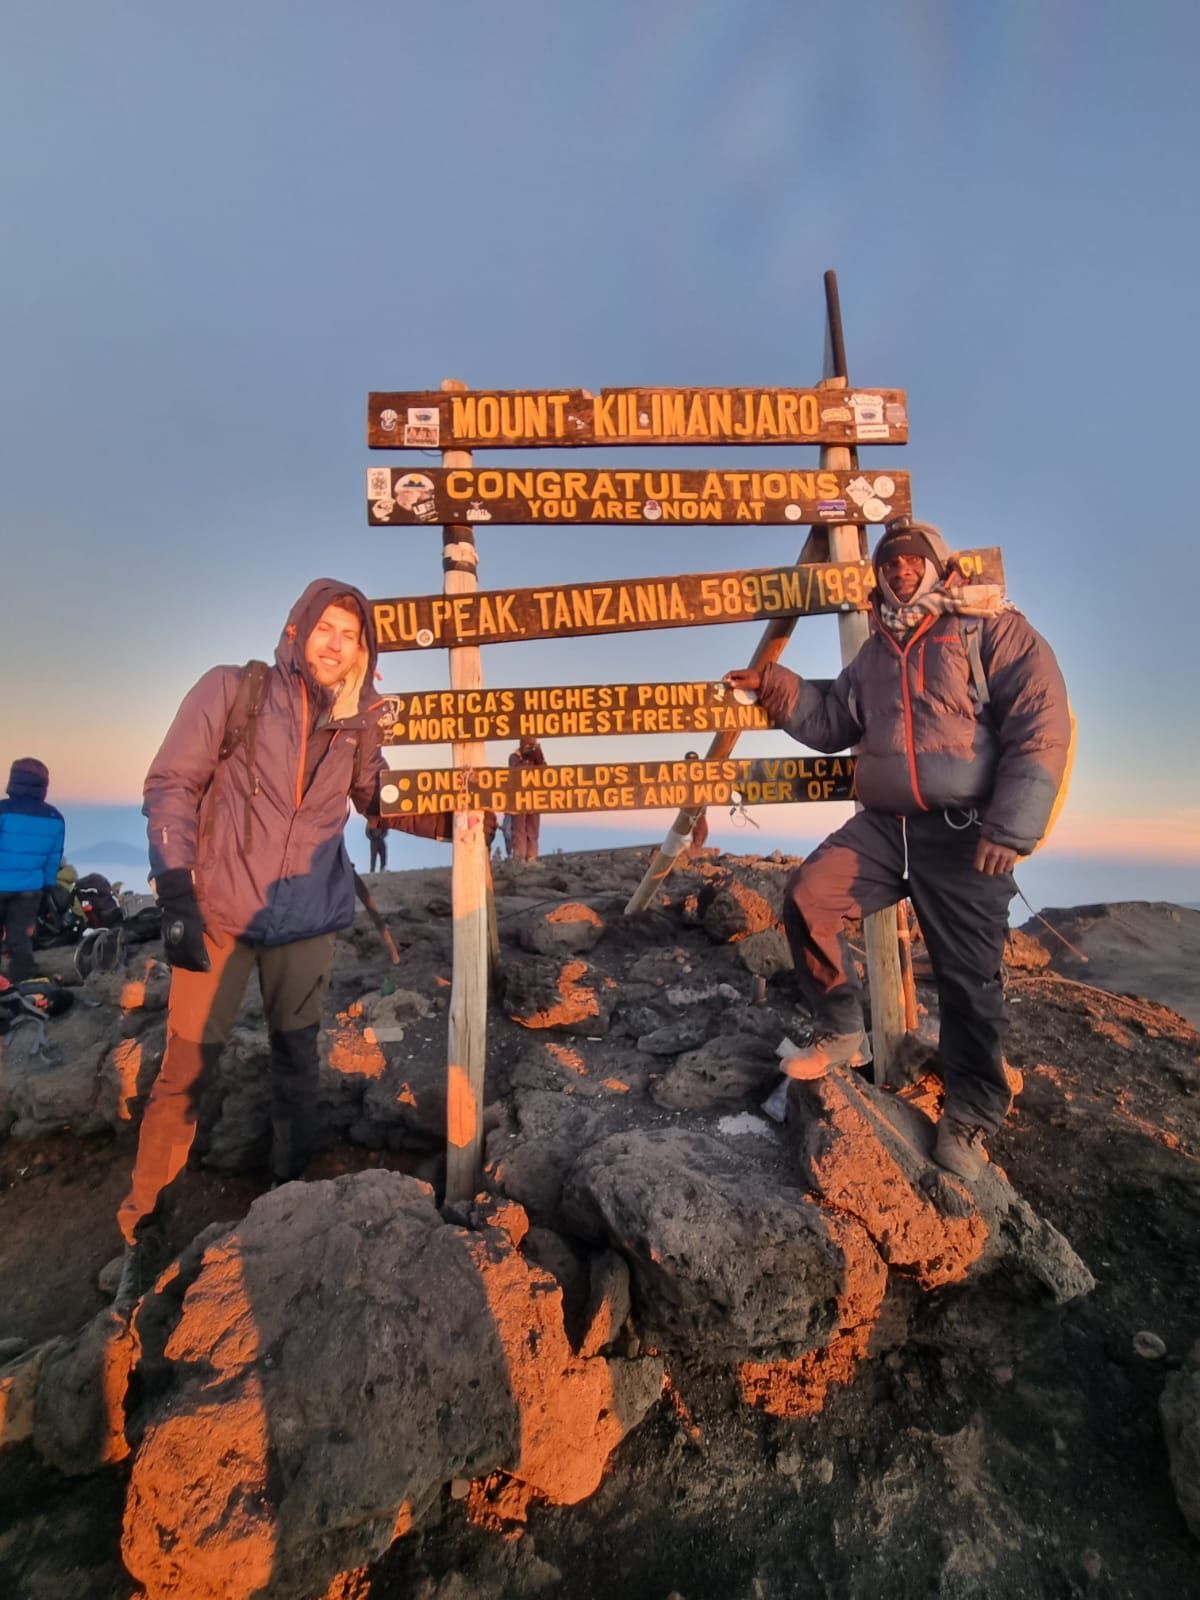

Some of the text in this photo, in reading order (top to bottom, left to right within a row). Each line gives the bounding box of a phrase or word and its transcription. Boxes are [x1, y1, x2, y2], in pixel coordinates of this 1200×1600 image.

[452, 394, 819, 438] MOUNT KILIMANJARO
[446, 471, 840, 500] CONGRATULATIONS
[527, 500, 765, 520] YOU ARE NOW AT
[432, 594, 526, 639] PEAK,
[533, 582, 695, 630] TANZANIA,
[409, 684, 707, 716] AFRICA'S HIGHEST POINT
[408, 714, 511, 741] WORLD'S
[520, 710, 625, 736] HIGHEST
[417, 771, 466, 792] ONE
[478, 769, 510, 789] OF
[521, 766, 629, 789] WORLD'S
[639, 761, 752, 784] LARGEST
[417, 791, 506, 815] WORLD
[515, 787, 635, 812] HERITAGE
[644, 785, 687, 806] AND
[807, 781, 835, 801] OF
